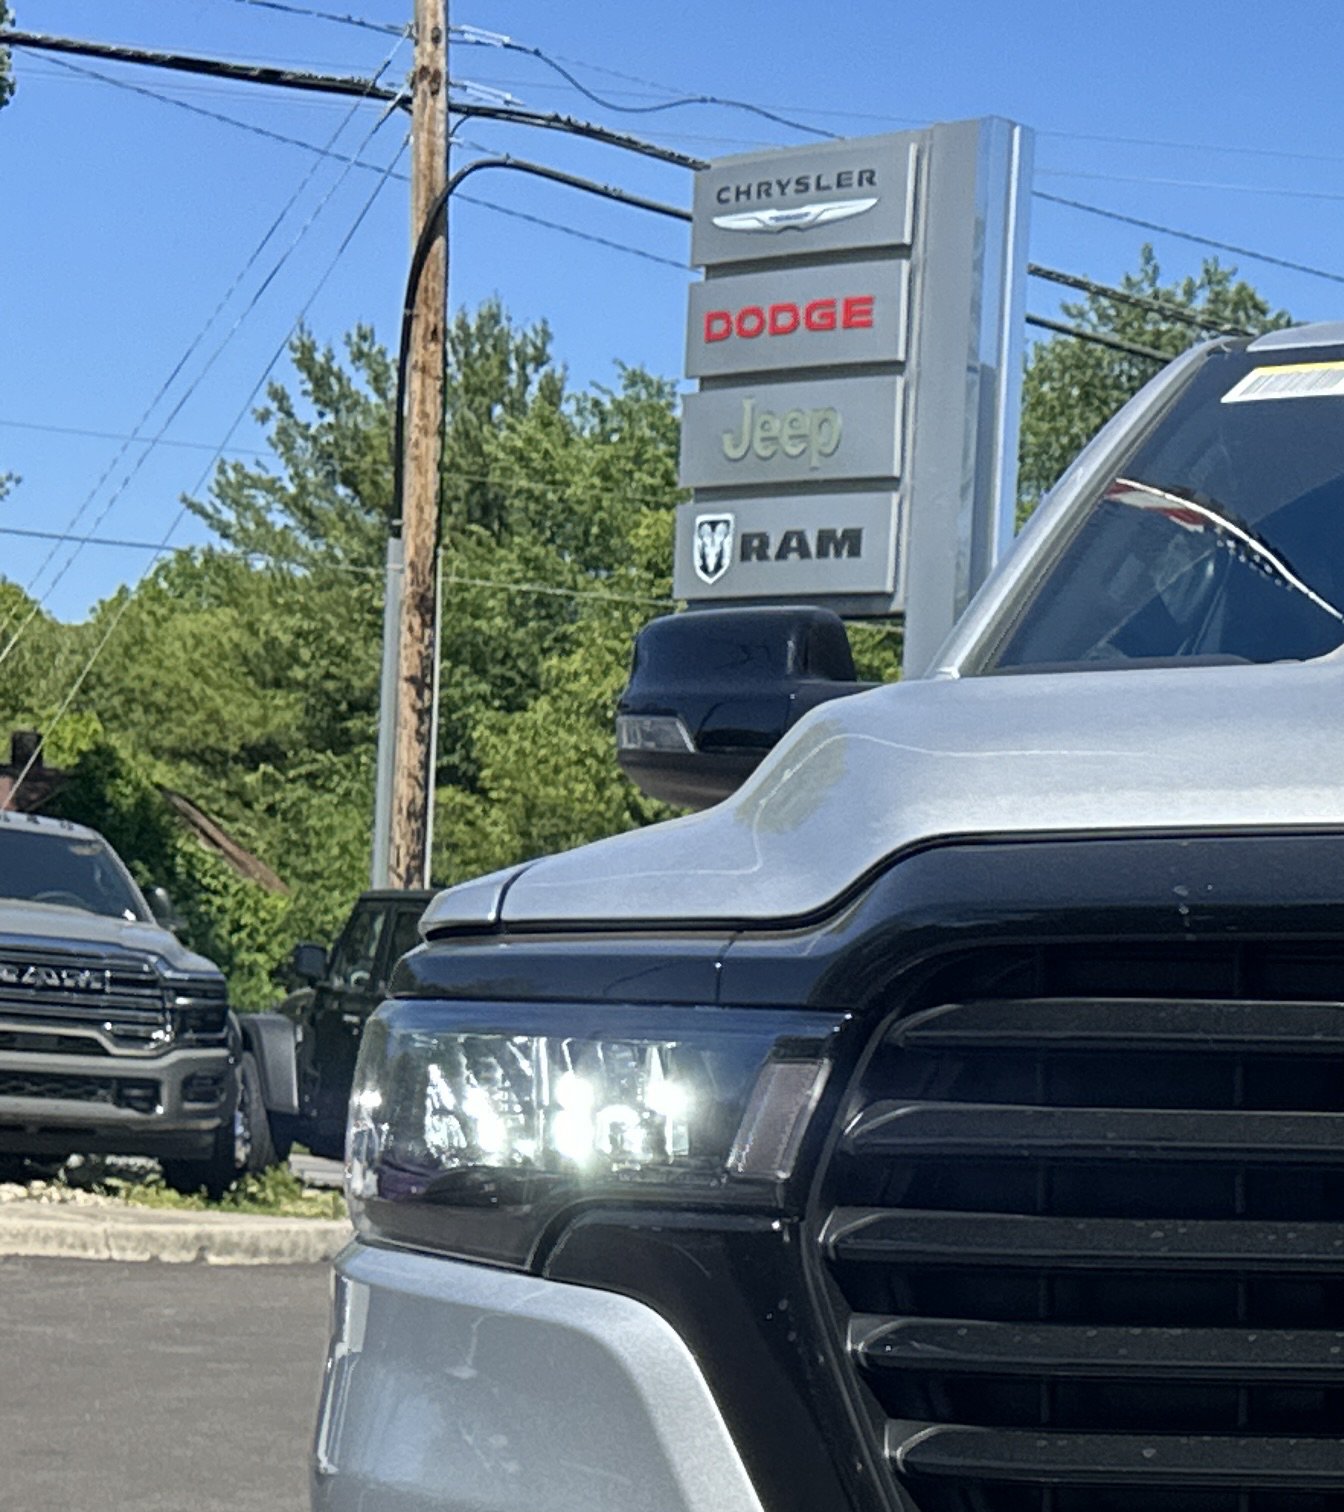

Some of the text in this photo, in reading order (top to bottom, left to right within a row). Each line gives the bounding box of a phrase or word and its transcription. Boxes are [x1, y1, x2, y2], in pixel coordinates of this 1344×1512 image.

[716, 168, 877, 204] CHRYSLER
[704, 295, 875, 343] DODGE
[722, 396, 842, 469] Jeep
[740, 528, 863, 561] RAM
